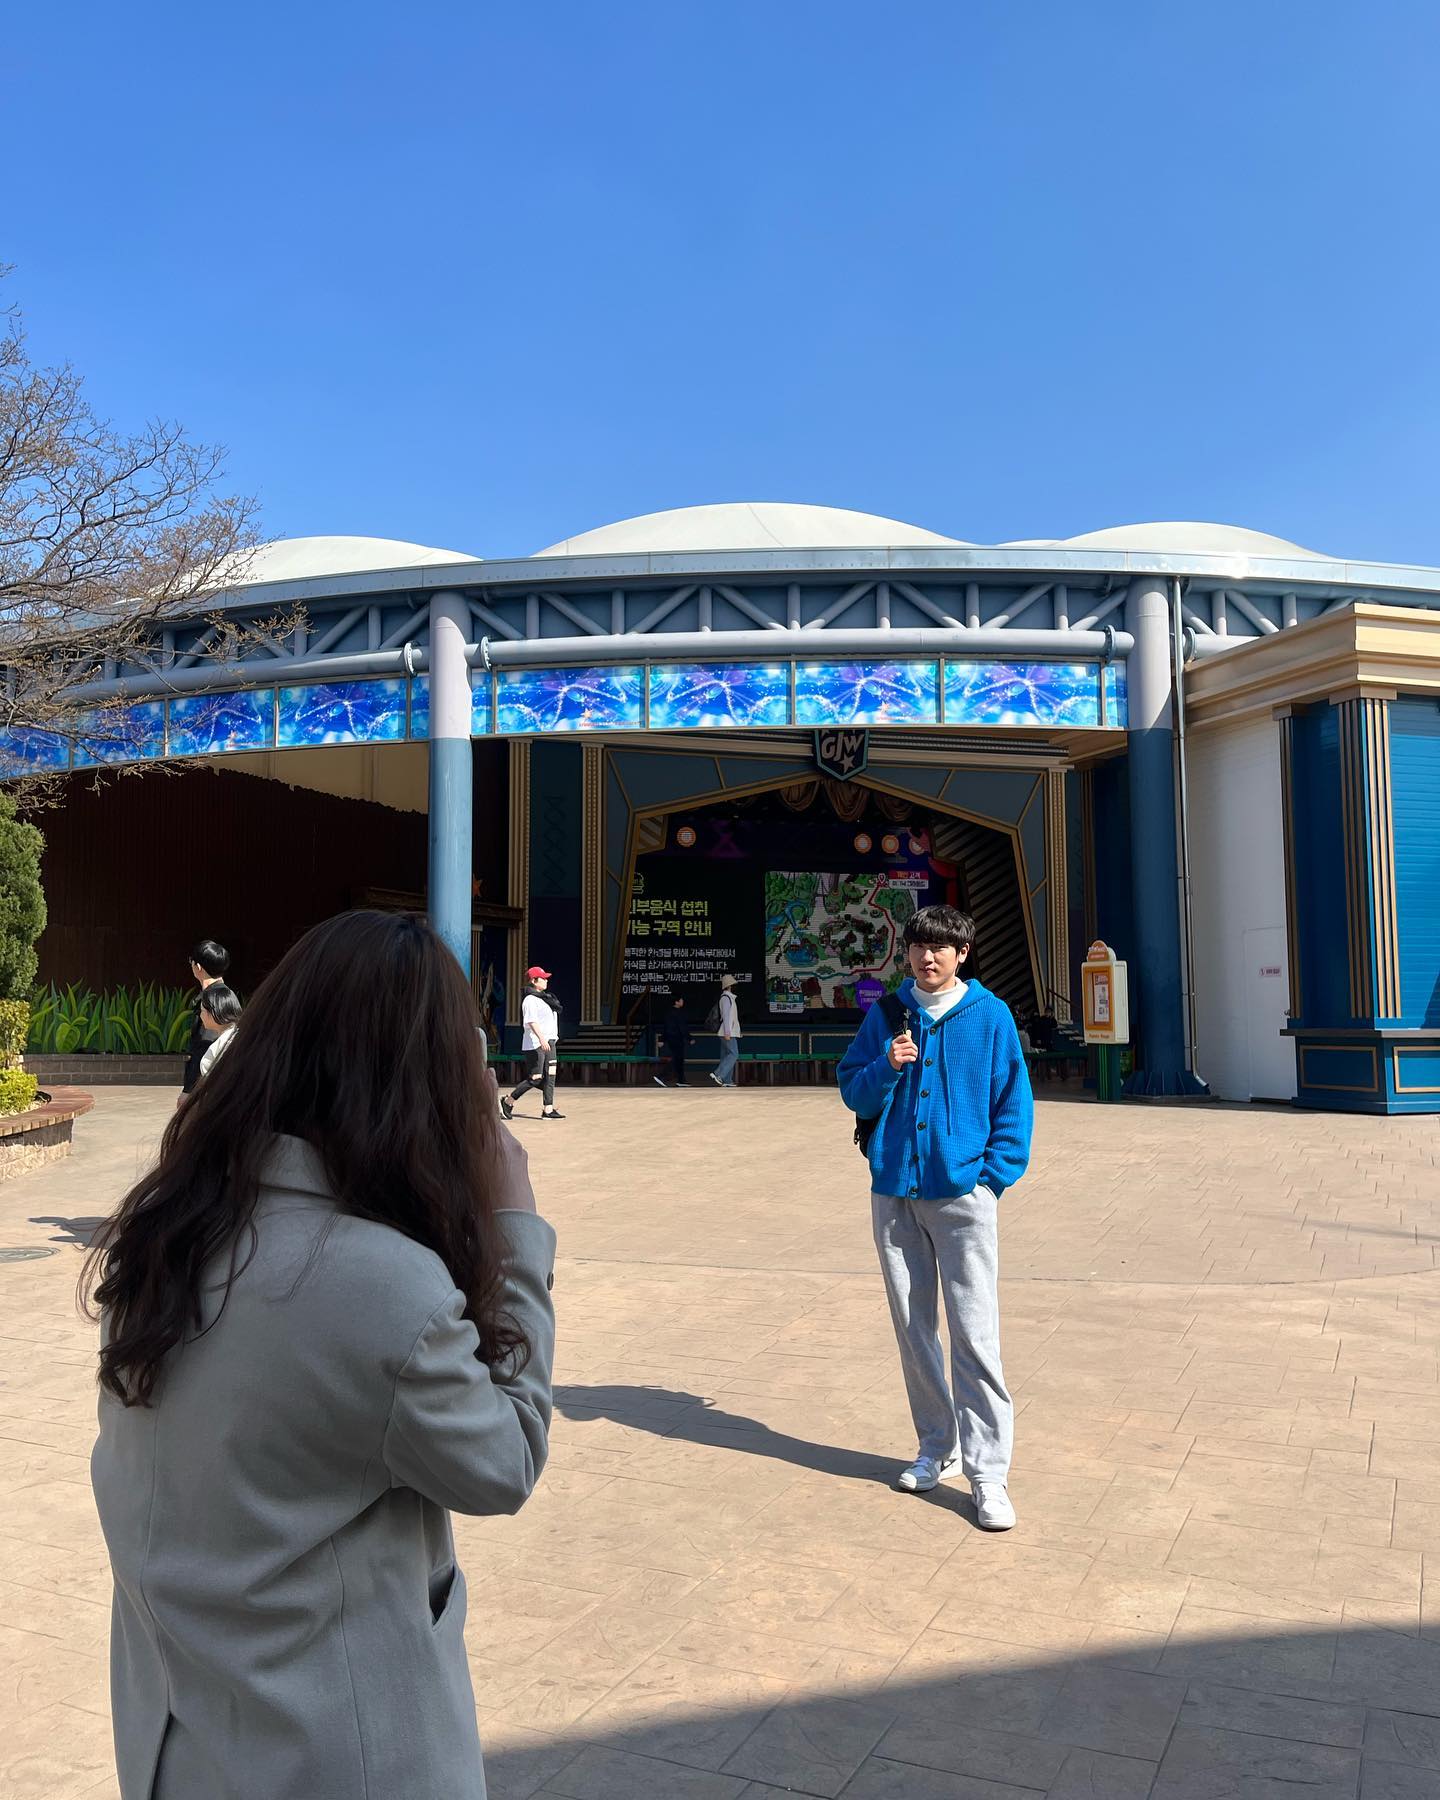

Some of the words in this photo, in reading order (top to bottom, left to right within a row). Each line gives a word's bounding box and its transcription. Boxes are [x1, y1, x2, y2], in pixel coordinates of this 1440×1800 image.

[681, 900, 709, 917] 섭취
[653, 920, 681, 936] 구역
[684, 920, 712, 936] 안내
[672, 948, 689, 957] 위해
